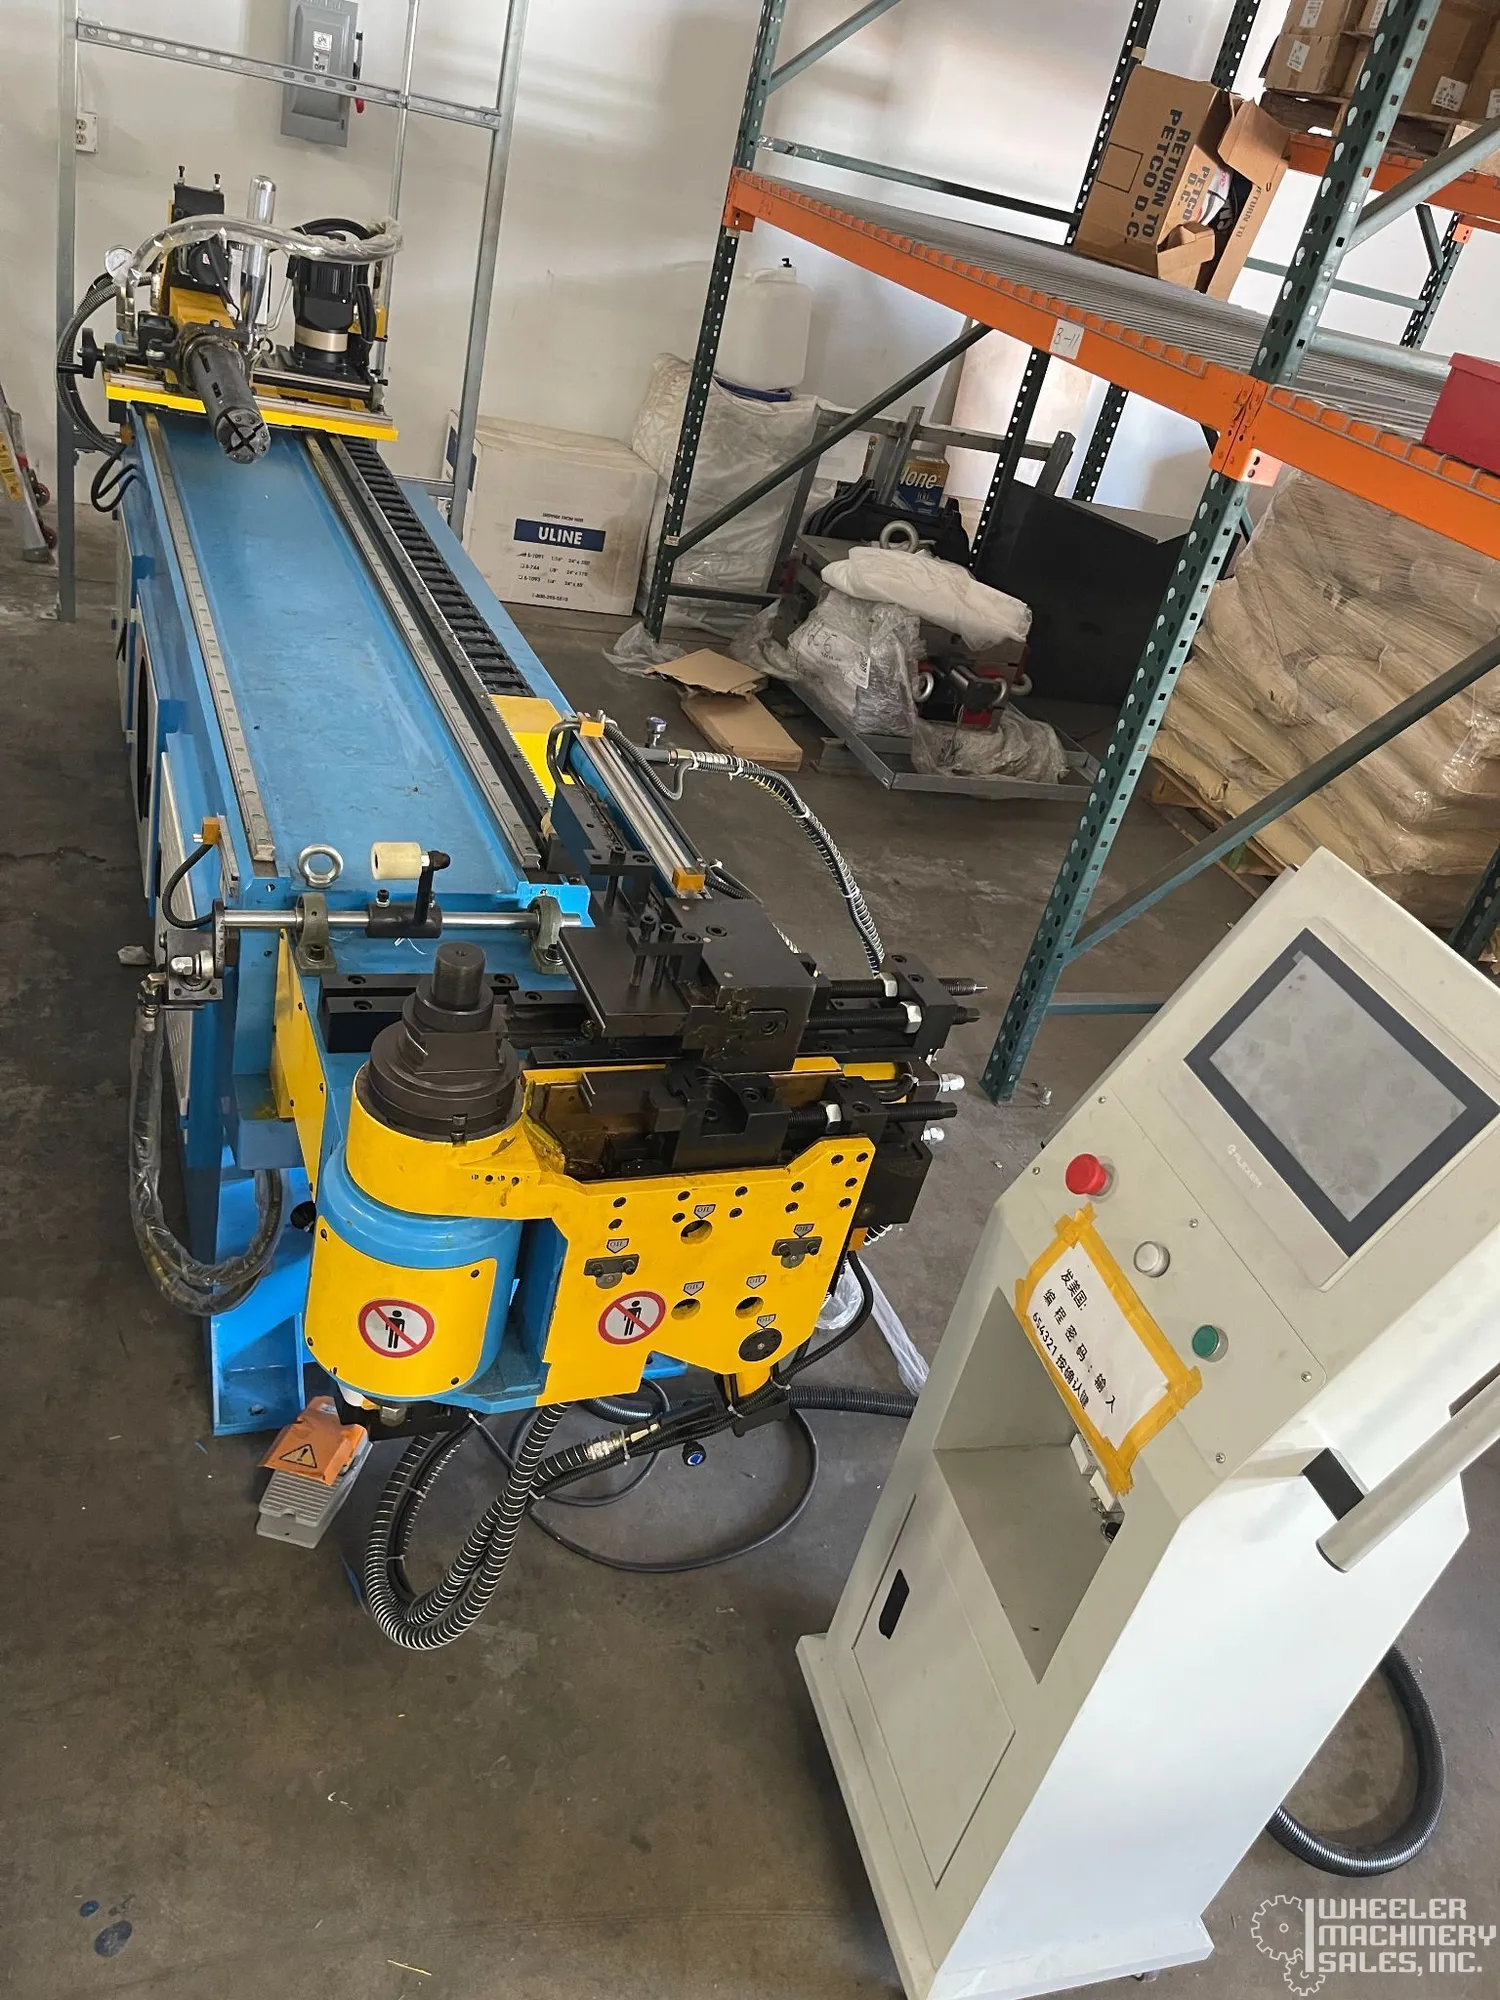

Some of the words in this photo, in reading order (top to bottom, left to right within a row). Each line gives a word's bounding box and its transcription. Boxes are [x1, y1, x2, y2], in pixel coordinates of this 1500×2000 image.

[1143, 109, 1183, 188] PETCO
[1152, 129, 1192, 208] RETURN
[1182, 166, 1211, 221] PETCO
[1242, 186, 1262, 222] ETURN
[1124, 195, 1149, 244] D.C.
[1142, 213, 1160, 238] TO
[538, 526, 583, 545] ULINE
